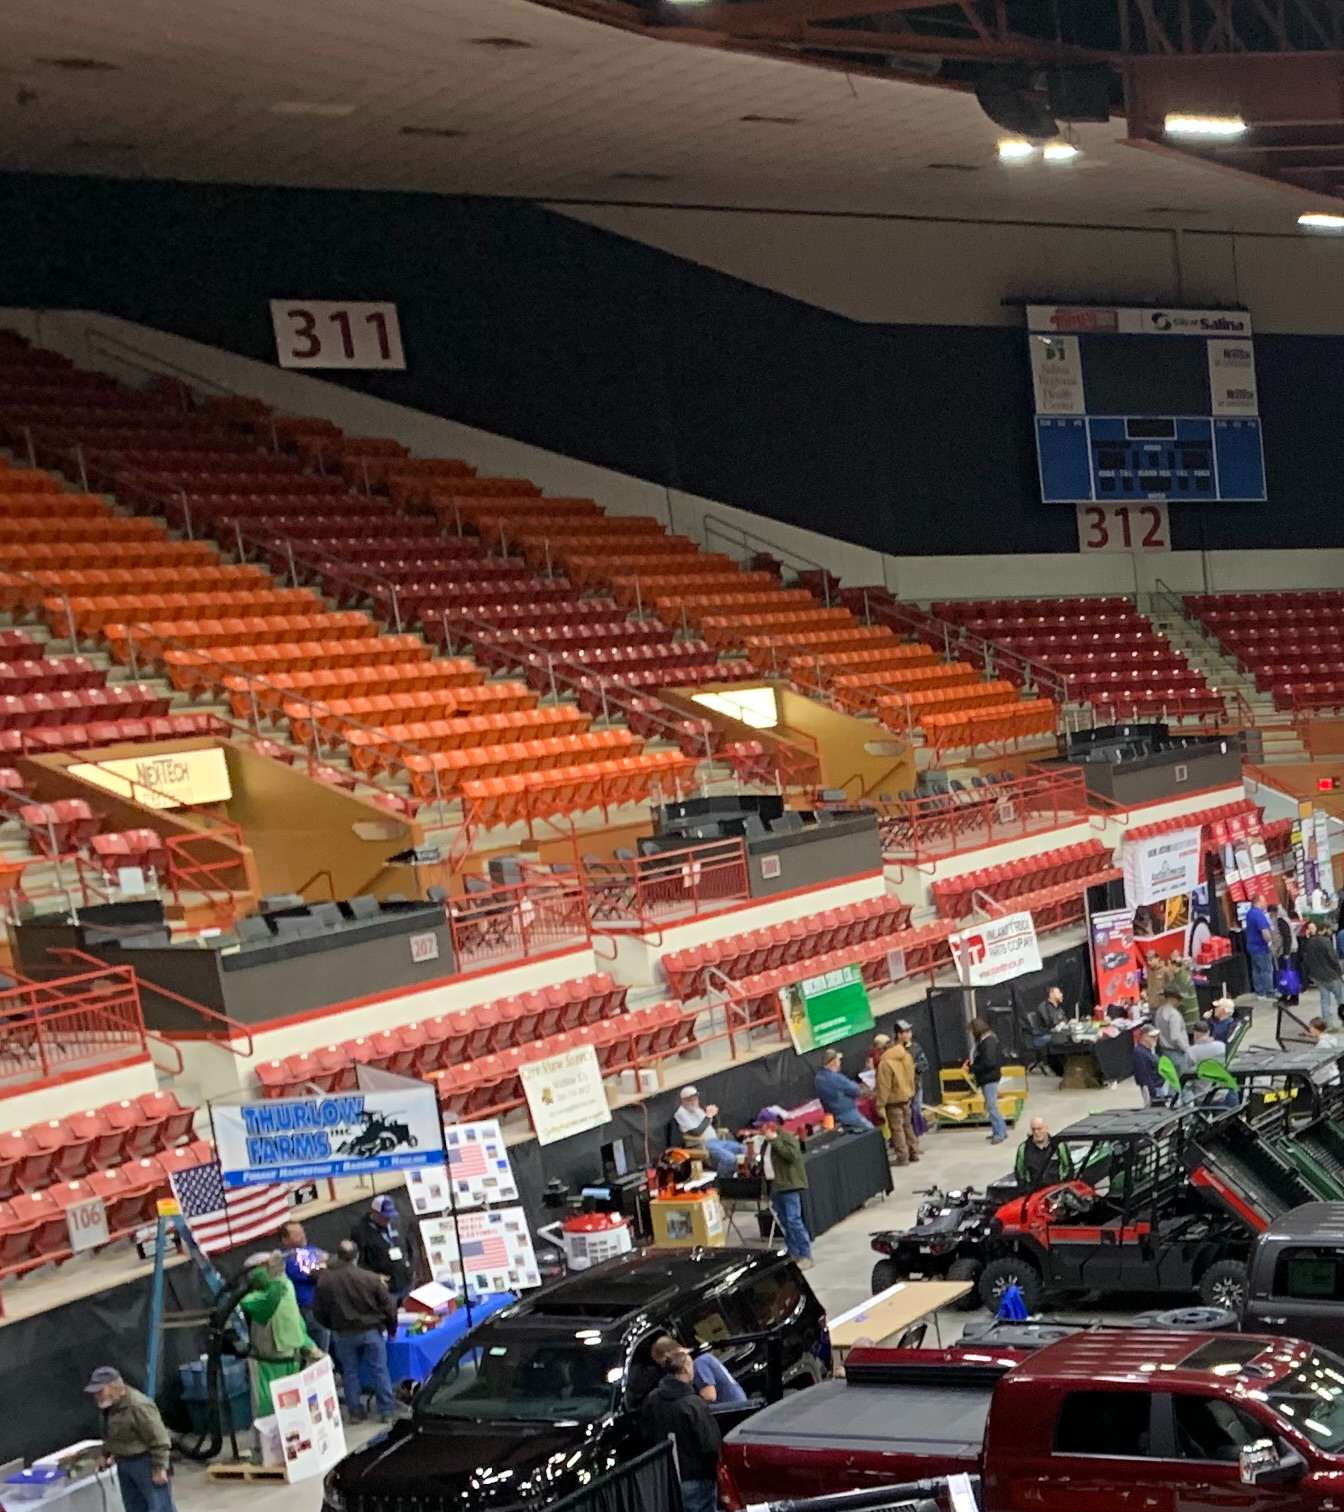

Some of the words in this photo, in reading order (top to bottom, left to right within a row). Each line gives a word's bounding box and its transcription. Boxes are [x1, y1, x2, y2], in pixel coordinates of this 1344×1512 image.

[286, 309, 394, 361] 311
[1200, 317, 1245, 331] Salina
[1086, 506, 1165, 548] 312
[241, 1096, 364, 1135] THURLOW
[246, 1131, 331, 1166] FARMS
[69, 1203, 104, 1228] 106
